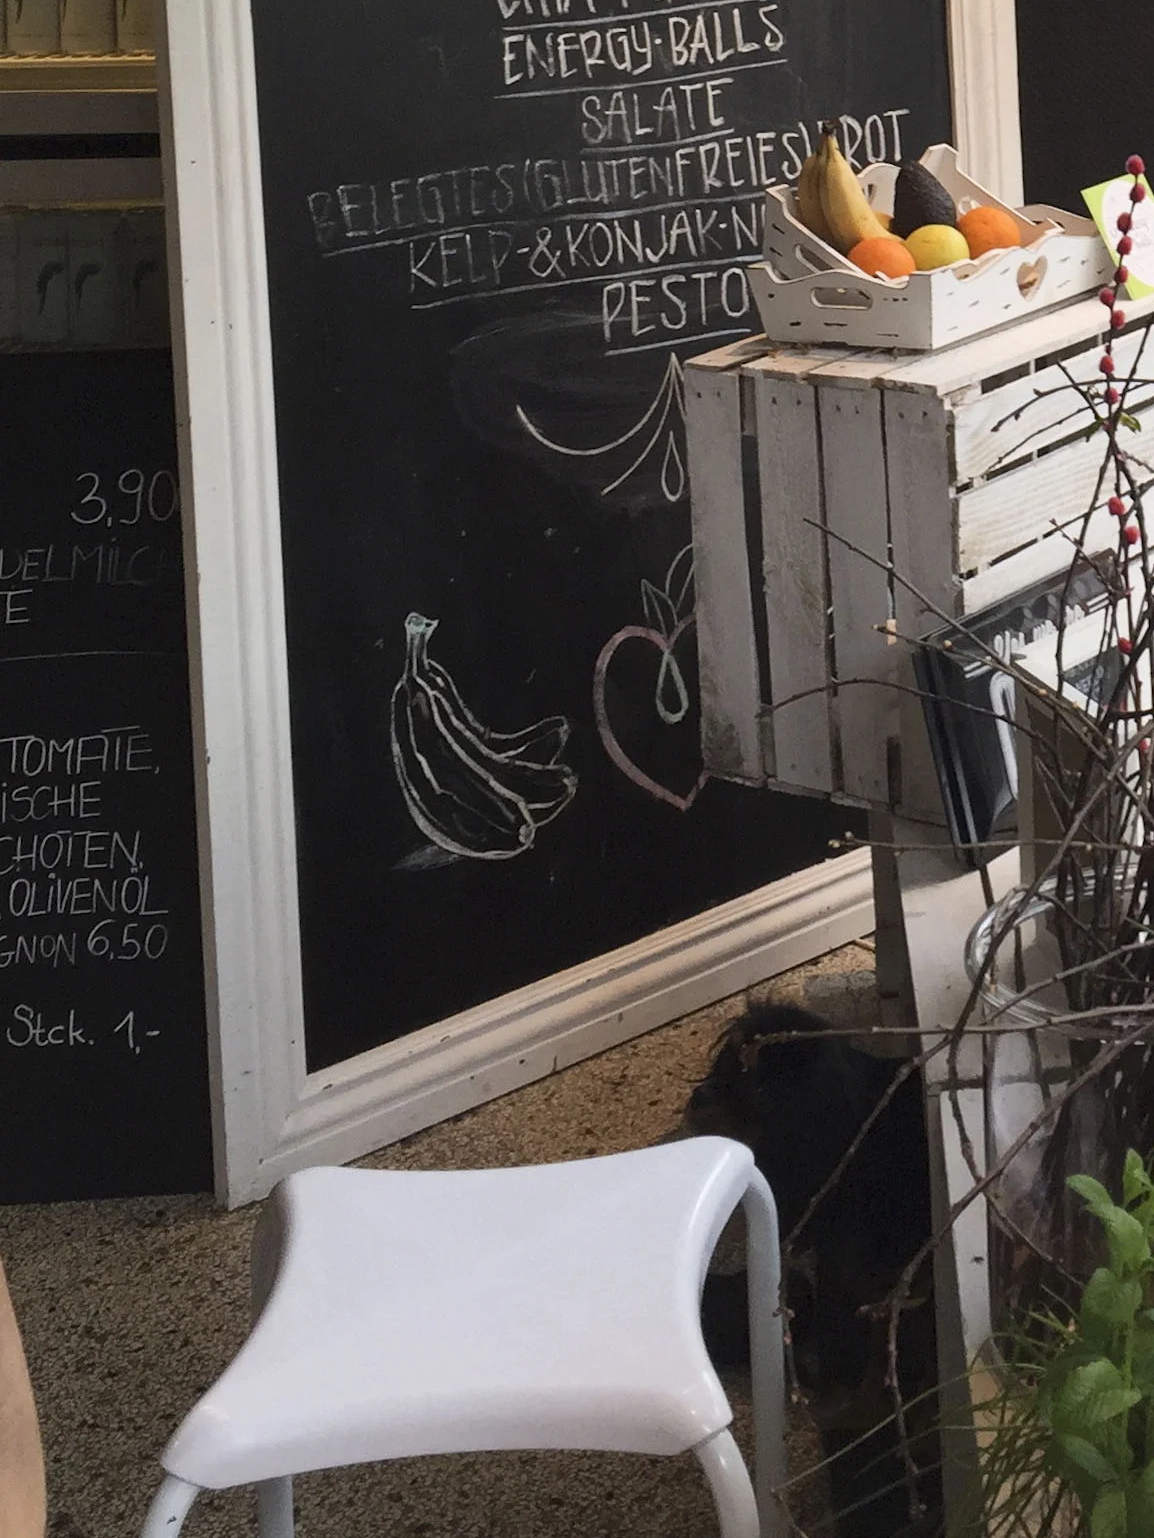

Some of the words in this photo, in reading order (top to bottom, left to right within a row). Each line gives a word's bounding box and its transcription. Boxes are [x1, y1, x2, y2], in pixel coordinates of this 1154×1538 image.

[582, 79, 735, 144] SALATE
[817, 108, 911, 170] ROT
[601, 266, 750, 341] PESTO
[71, 468, 176, 528] 3,90
[88, 918, 168, 961] 6,50
[6, 1003, 95, 1048] Stck.
